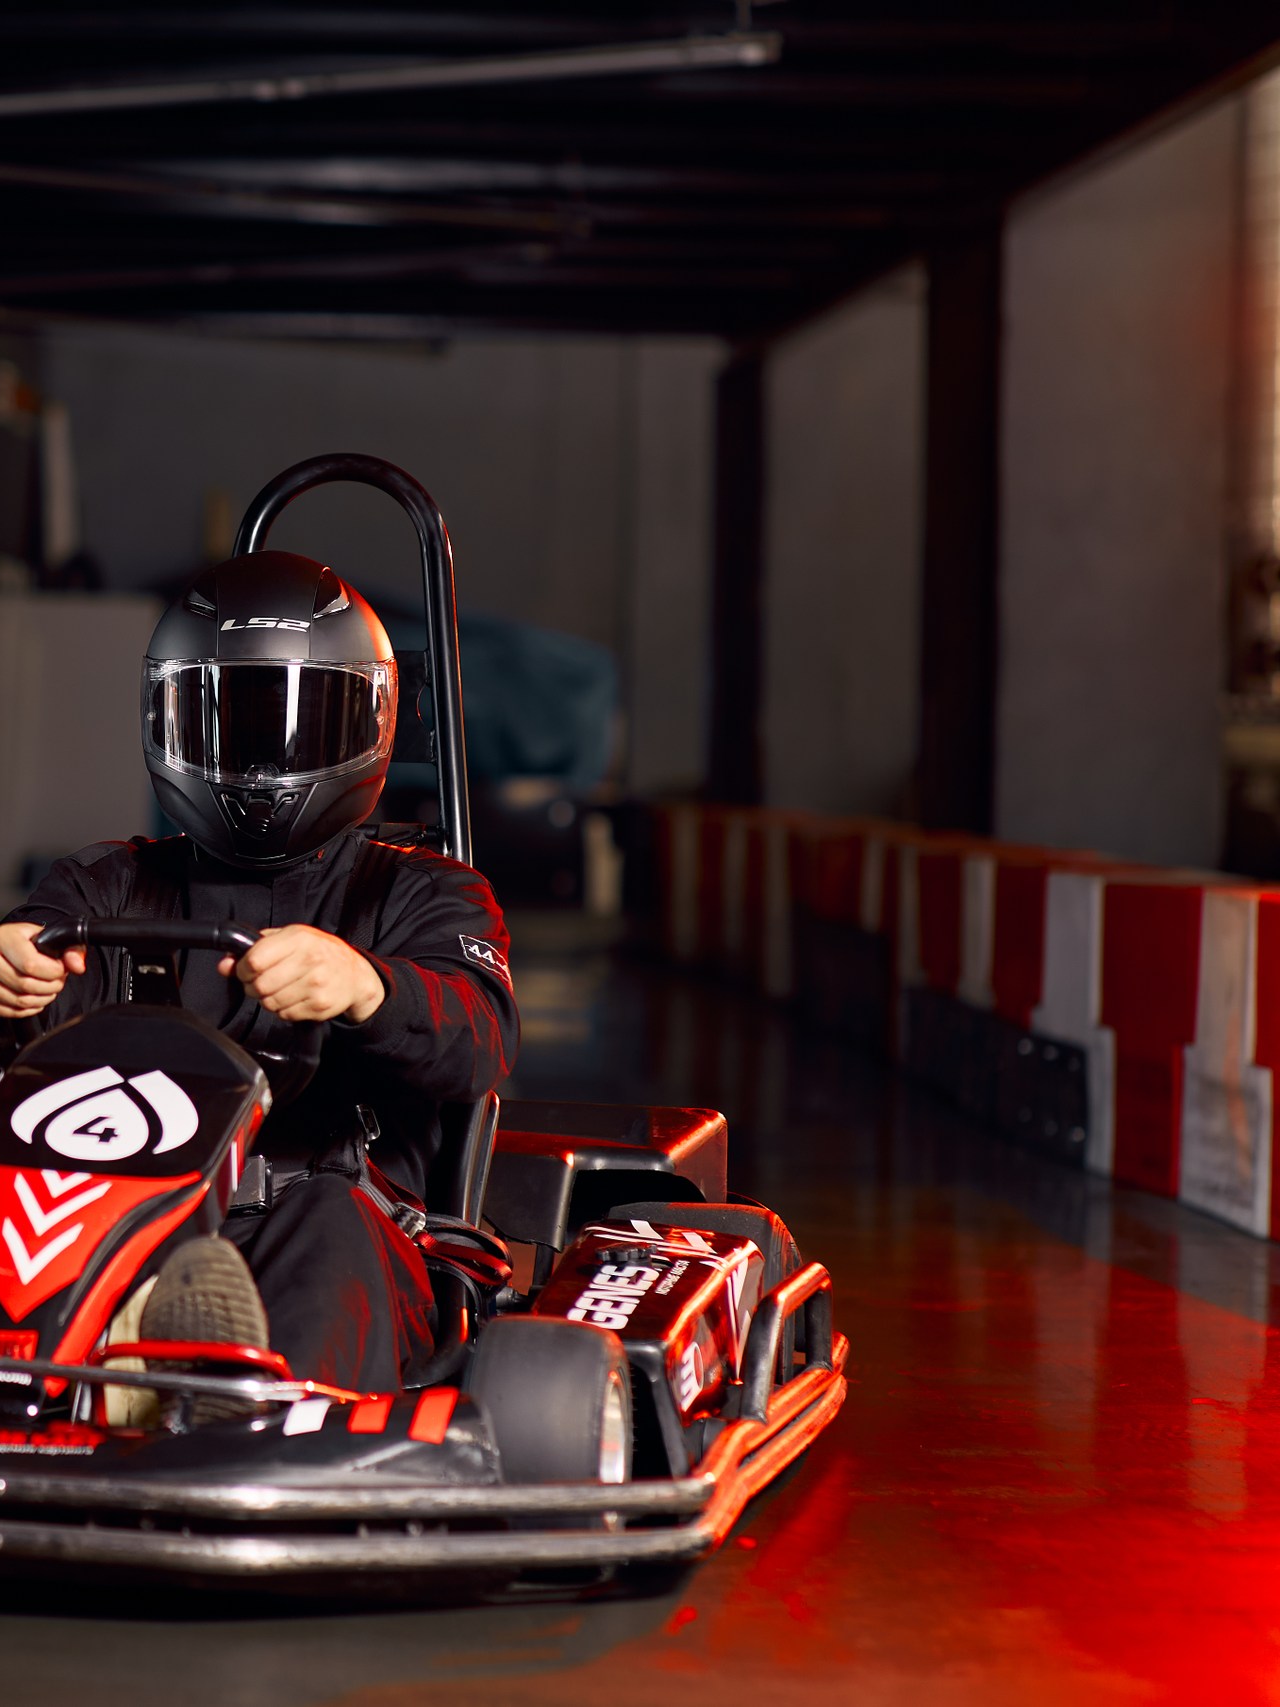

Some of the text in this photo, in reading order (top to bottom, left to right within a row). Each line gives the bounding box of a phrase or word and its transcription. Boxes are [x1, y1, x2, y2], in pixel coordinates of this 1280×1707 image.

[220, 617, 311, 633] LS2
[72, 1115, 119, 1143] 4
[567, 1255, 670, 1330] GENES
